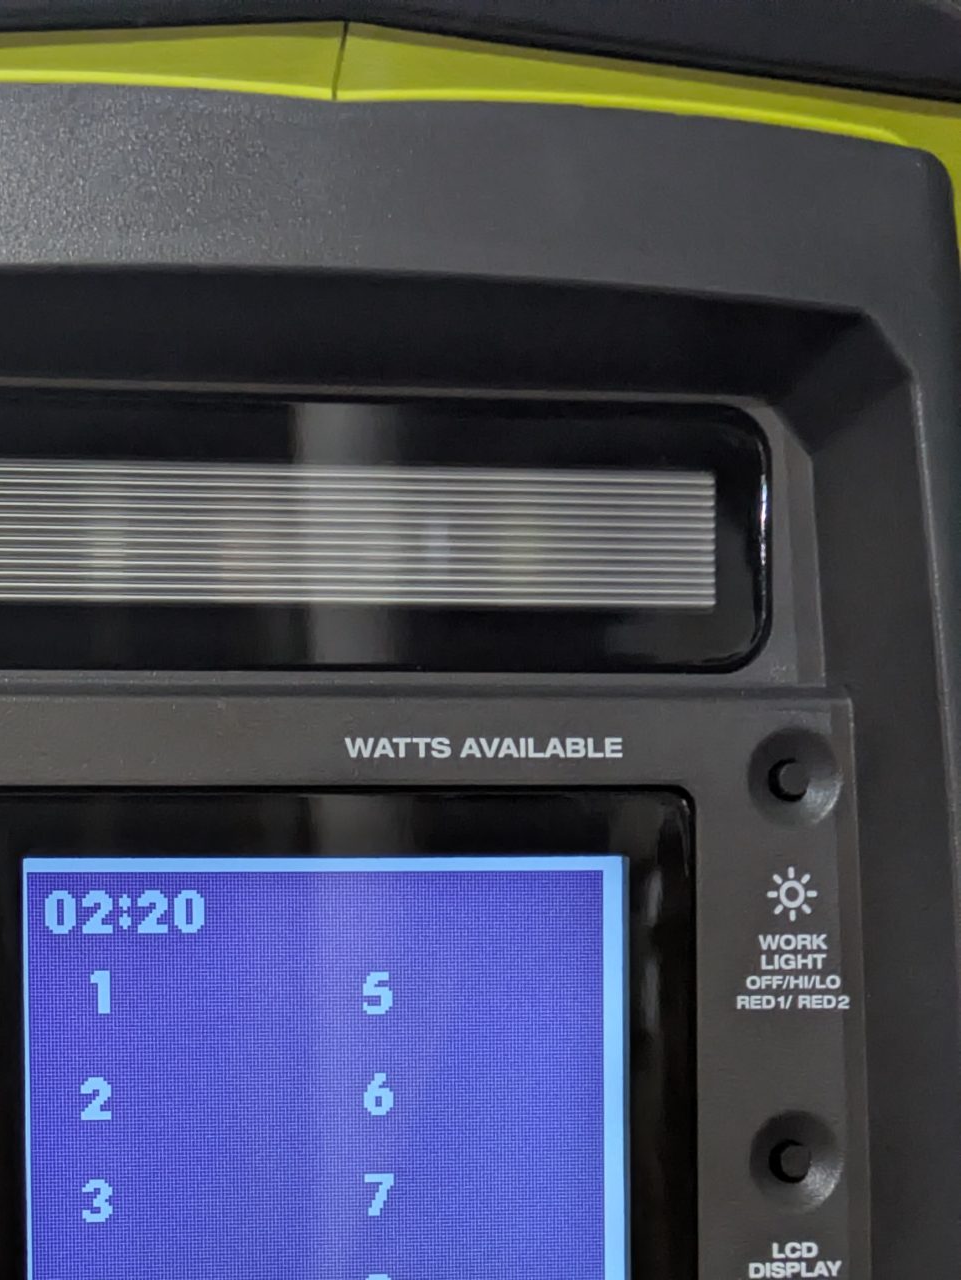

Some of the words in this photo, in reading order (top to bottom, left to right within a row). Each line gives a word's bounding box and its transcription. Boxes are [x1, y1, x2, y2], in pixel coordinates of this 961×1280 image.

[345, 738, 451, 758] WATTS
[460, 738, 623, 758] AVAILABLE
[45, 890, 205, 934] 02:20
[759, 934, 827, 950] WORK
[761, 954, 826, 970] LIGHT
[90, 970, 110, 1014] 1
[363, 972, 393, 1014] 5
[746, 975, 840, 989] OFF/HI/LO
[798, 995, 849, 1009] RED2
[80, 1077, 112, 1120] 2
[364, 1073, 393, 1115] 6
[82, 1179, 113, 1223] 3
[364, 1173, 394, 1216] 7
[772, 1242, 818, 1258] LCD
[749, 1261, 841, 1278] DISPLAY
